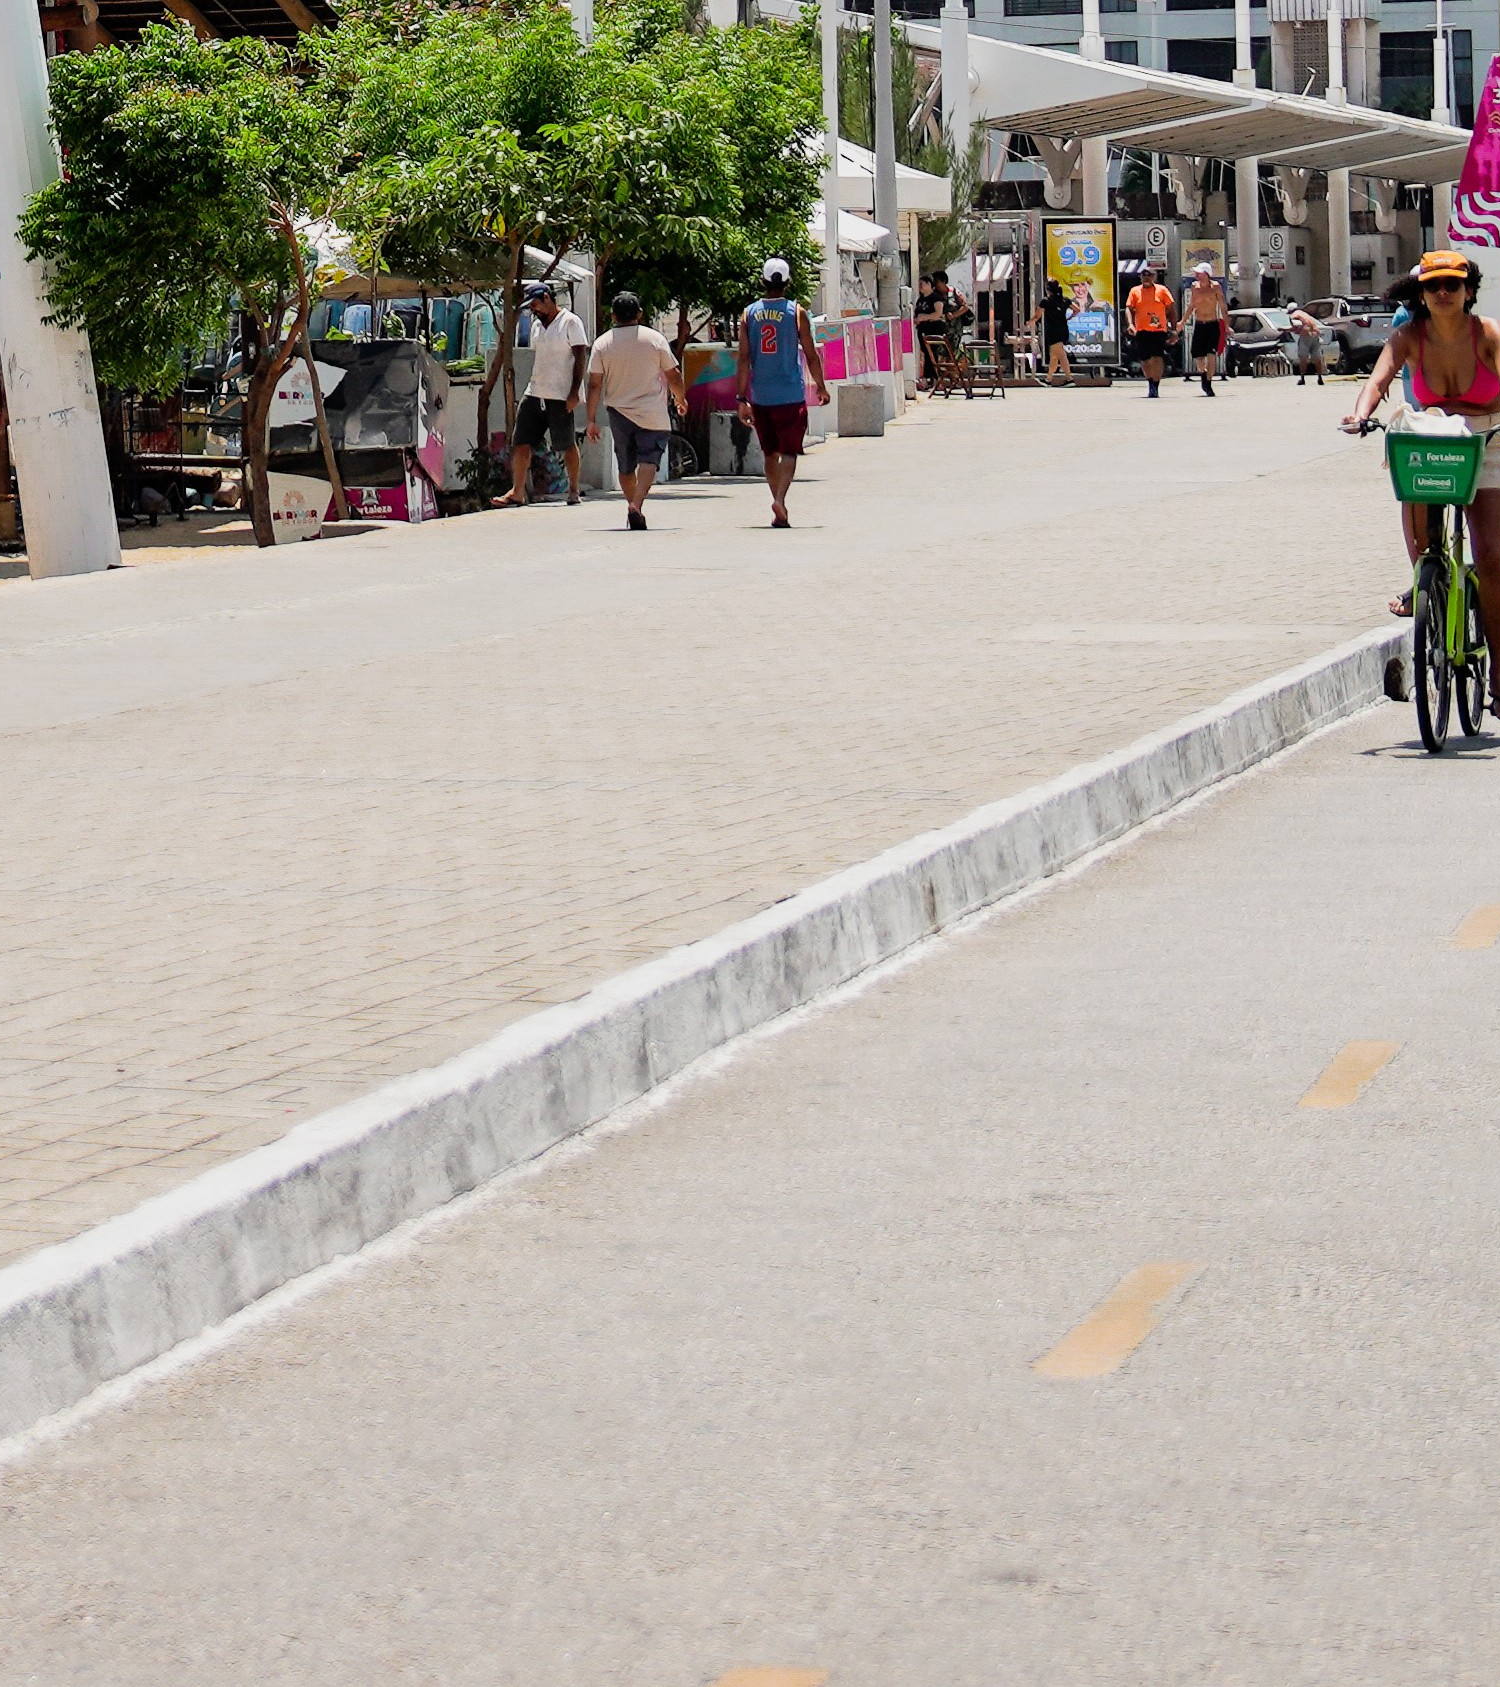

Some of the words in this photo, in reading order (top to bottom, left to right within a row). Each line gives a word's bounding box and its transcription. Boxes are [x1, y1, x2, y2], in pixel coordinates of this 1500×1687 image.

[1153, 231, 1160, 242] E
[1059, 245, 1101, 266] 9.9
[754, 308, 785, 323] IRVING
[761, 324, 777, 354] 2
[1426, 452, 1465, 462] Fortaleza
[359, 504, 393, 515] rtaleza
